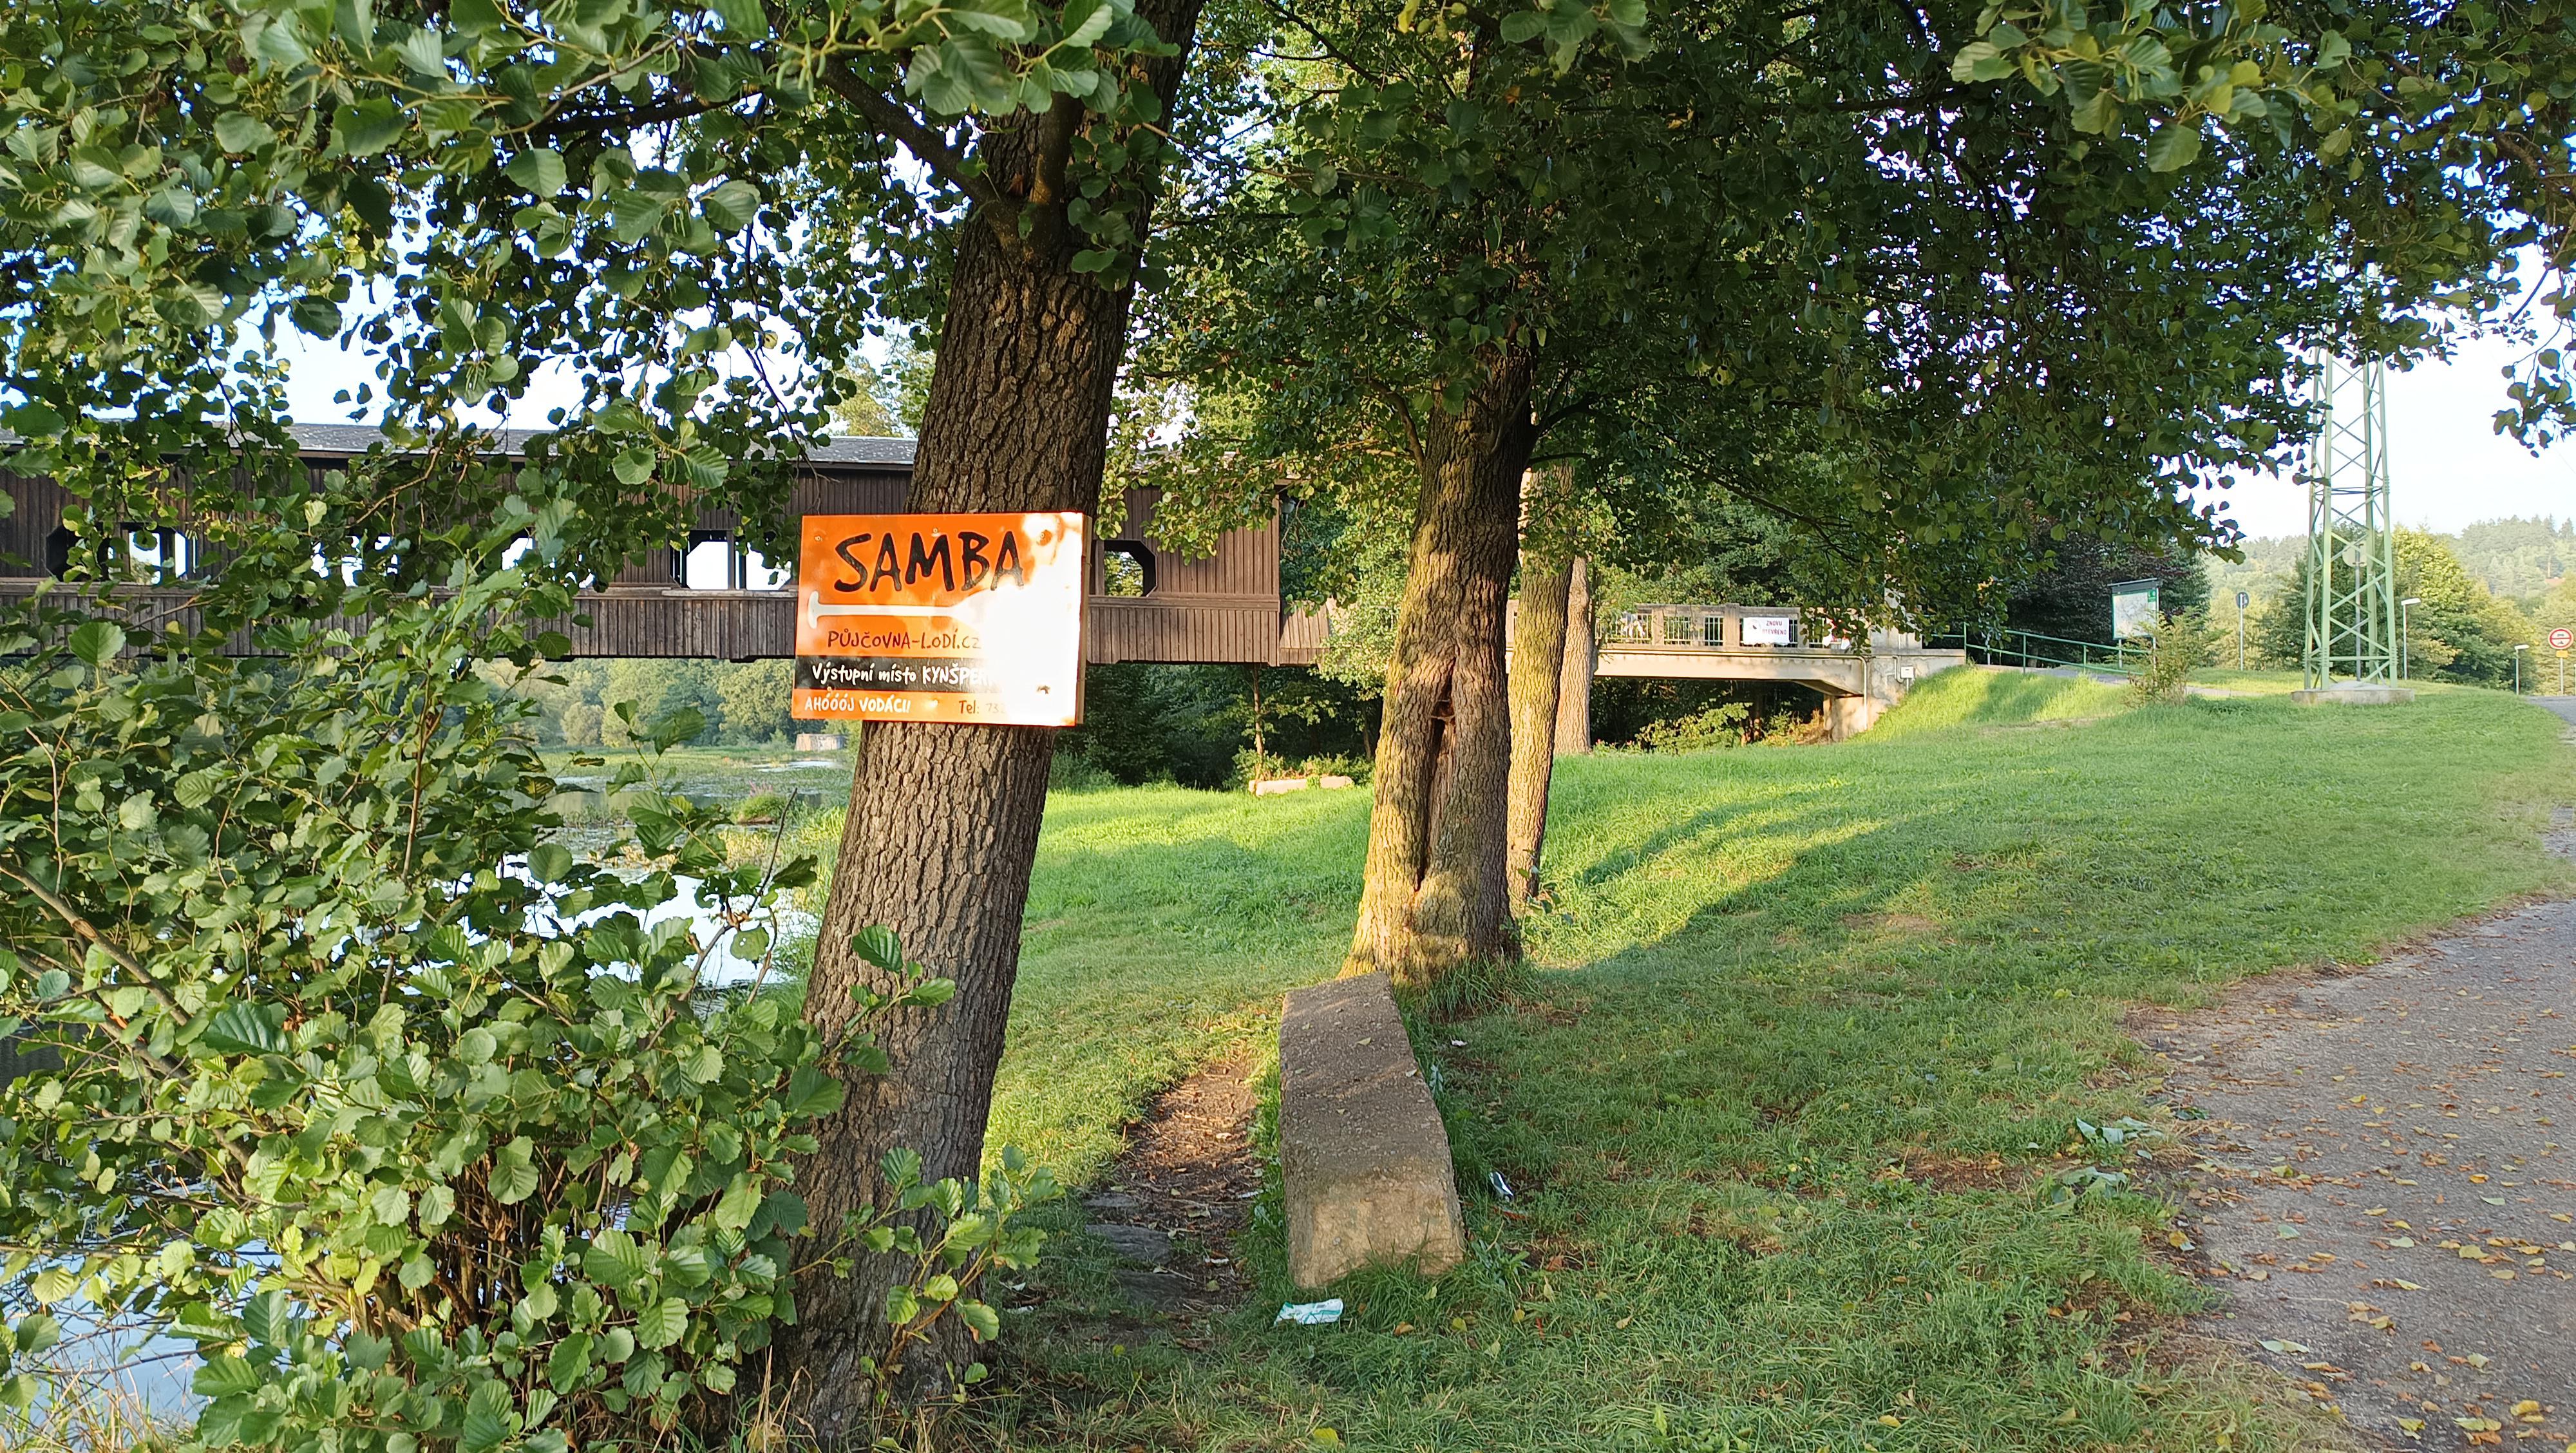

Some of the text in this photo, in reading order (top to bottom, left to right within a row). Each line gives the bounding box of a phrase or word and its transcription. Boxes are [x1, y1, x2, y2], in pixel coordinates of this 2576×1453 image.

[834, 531, 1024, 593] SAMBA
[828, 628, 982, 649] PŮJČOVNA-LODÍ.CZ
[812, 661, 875, 686] Výstupní
[878, 663, 916, 685] místo
[805, 693, 855, 712] AHÓÓÓJ
[959, 699, 979, 714] Tel:
